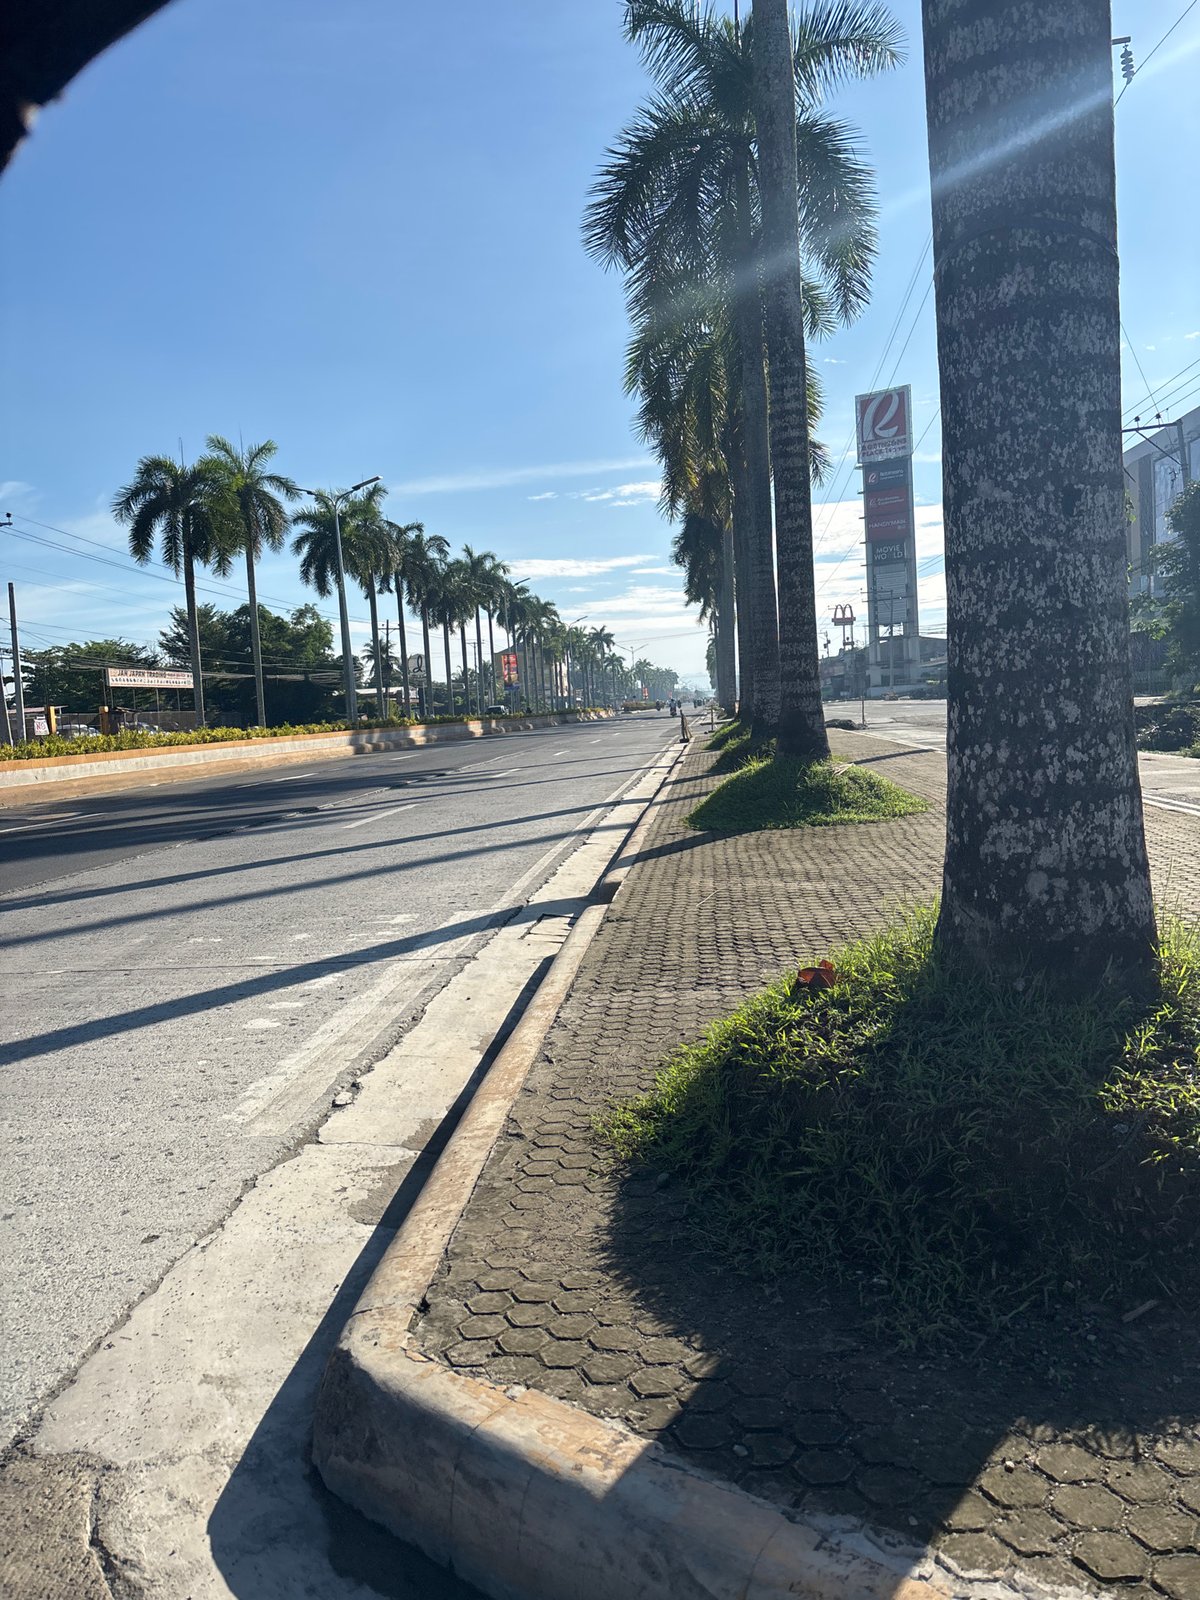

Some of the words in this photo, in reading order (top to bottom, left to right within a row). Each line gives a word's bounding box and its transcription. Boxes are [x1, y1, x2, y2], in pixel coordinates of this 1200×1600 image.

[876, 544, 900, 553] MOVIE
[118, 669, 127, 677] JAN
[129, 670, 145, 678] JAPAN
